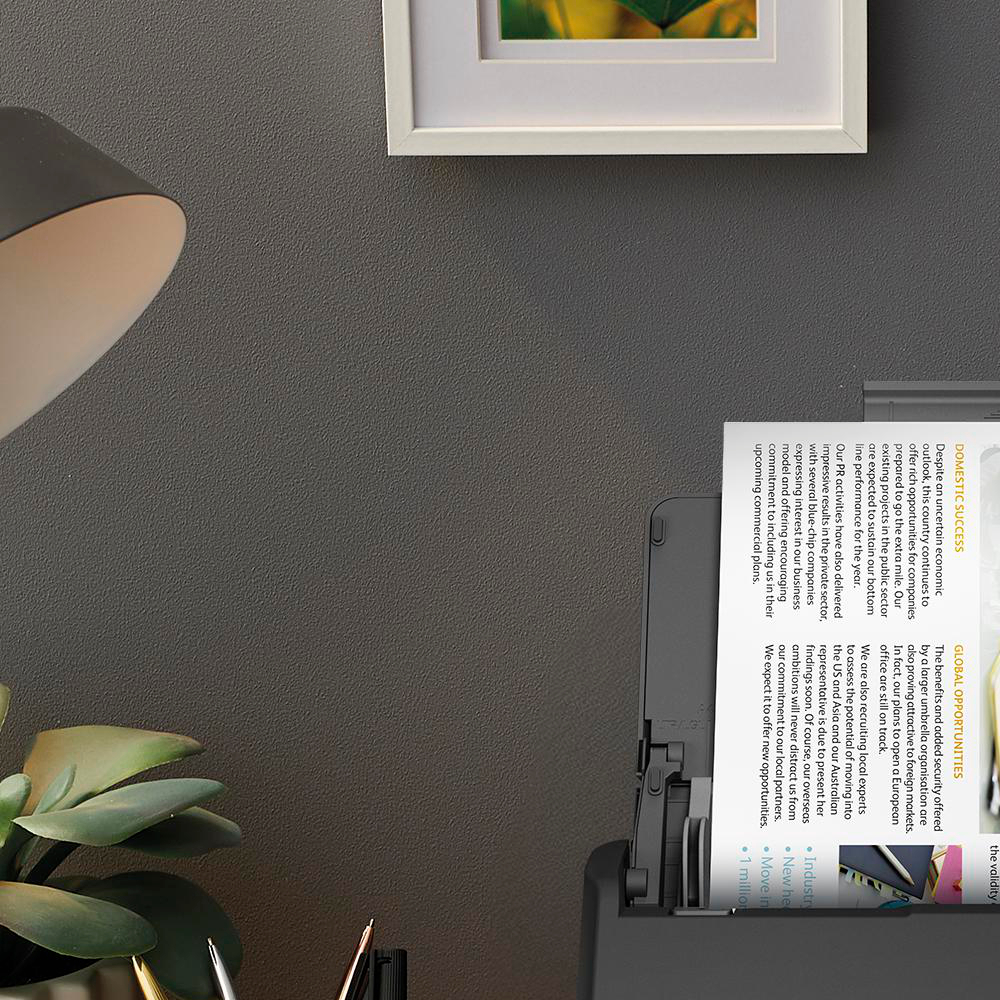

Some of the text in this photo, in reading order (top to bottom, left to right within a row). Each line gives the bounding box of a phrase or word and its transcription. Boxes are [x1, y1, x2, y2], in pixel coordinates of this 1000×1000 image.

[851, 443, 865, 589] line performance for the year.
[892, 443, 905, 609] prepared to go the extra mile. Our
[919, 442, 932, 607] outlook, this country continues to
[933, 443, 946, 596] Despite an uncertain economic
[954, 443, 965, 553] DOMESTIC SUCCESS
[833, 443, 846, 618] Our PR activities have also delivered
[865, 442, 877, 615] are expected to sustain our bottom
[878, 443, 891, 618] existing projects in the public sector
[905, 442, 919, 620] offer rich opportunities for companies
[892, 657, 903, 680] fact,
[893, 645, 903, 655] In
[918, 644, 931, 657] by
[878, 644, 890, 755] office are still on track.
[892, 681, 901, 698] our
[918, 667, 931, 696] larger
[953, 644, 964, 779] GLOBAL OPPORTUNITIES
[890, 699, 903, 727] plans
[892, 728, 902, 740] to
[903, 643, 917, 834] also proving attractive to foreign markets.
[920, 698, 930, 742] umbrella
[931, 644, 945, 832] The benefits and added security offered
[890, 741, 900, 766] open
[917, 743, 929, 807] organisation
[889, 777, 902, 825] European
[919, 809, 927, 826] are
[760, 857, 773, 893] Move
[782, 857, 795, 886] New
[988, 845, 1000, 901] the validity
